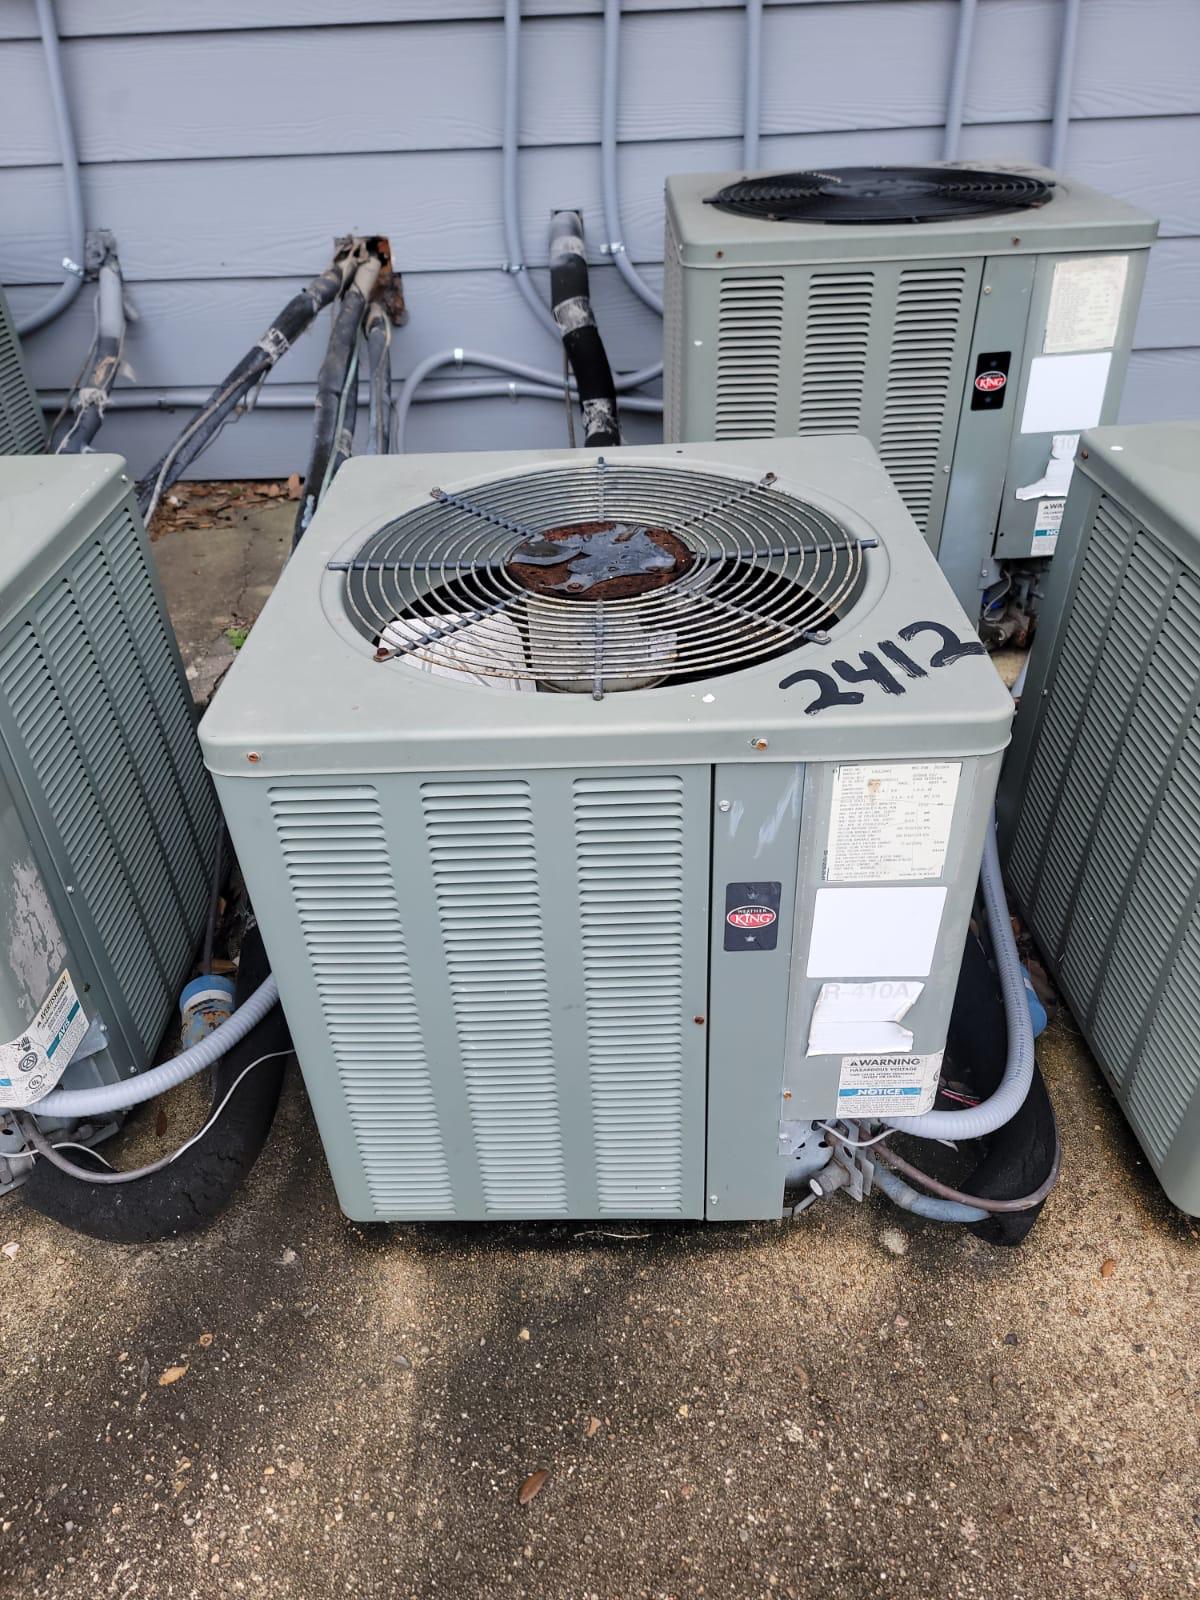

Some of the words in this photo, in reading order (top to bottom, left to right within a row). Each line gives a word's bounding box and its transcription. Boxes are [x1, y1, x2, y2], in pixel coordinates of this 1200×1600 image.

[979, 377, 1003, 389] KING
[779, 620, 987, 716] 2412
[737, 907, 767, 915] WEATHER
[734, 913, 770, 926] KING
[824, 983, 909, 1000] R-410A
[57, 1018, 71, 1041] AVIS
[859, 1058, 921, 1066] WARNING
[856, 1088, 902, 1096] NOTICE
